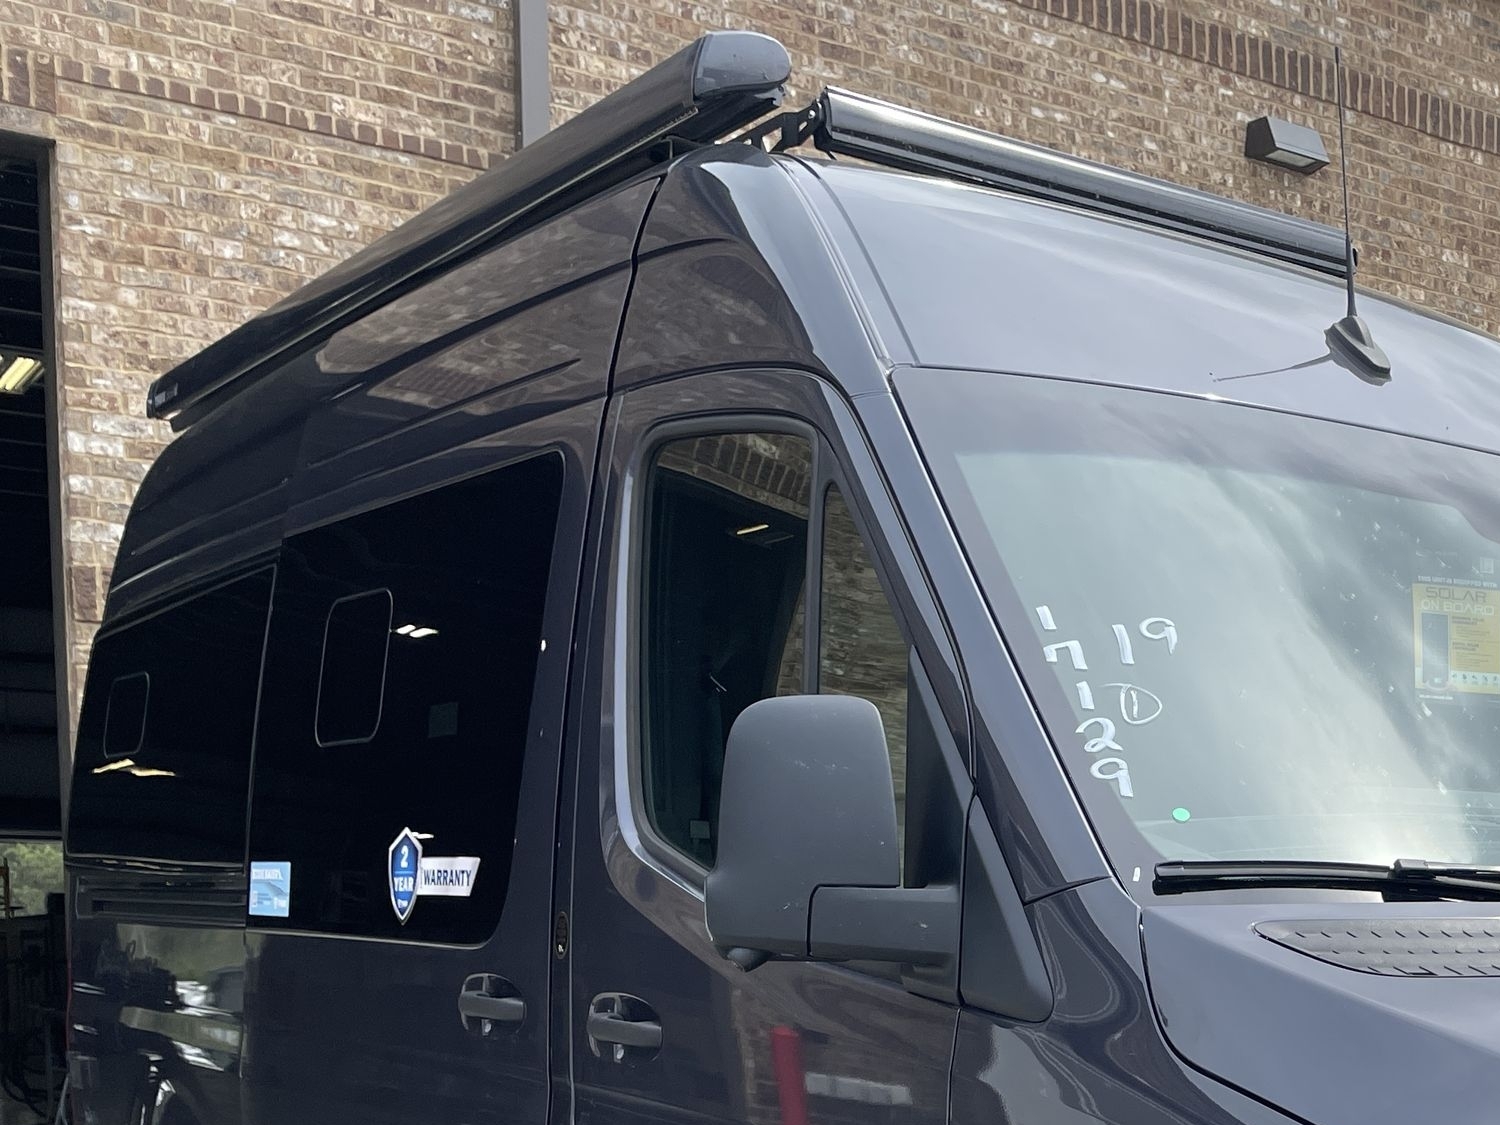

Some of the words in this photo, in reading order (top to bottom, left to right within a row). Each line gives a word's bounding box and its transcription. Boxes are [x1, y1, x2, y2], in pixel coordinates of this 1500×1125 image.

[1426, 586, 1487, 603] SOLAR
[1421, 599, 1440, 611] ON
[1444, 601, 1495, 616] BOARD
[1111, 617, 1178, 665] 19
[400, 845, 409, 869] 2
[393, 876, 414, 892] YEAR
[423, 869, 472, 887] WARRANTY
